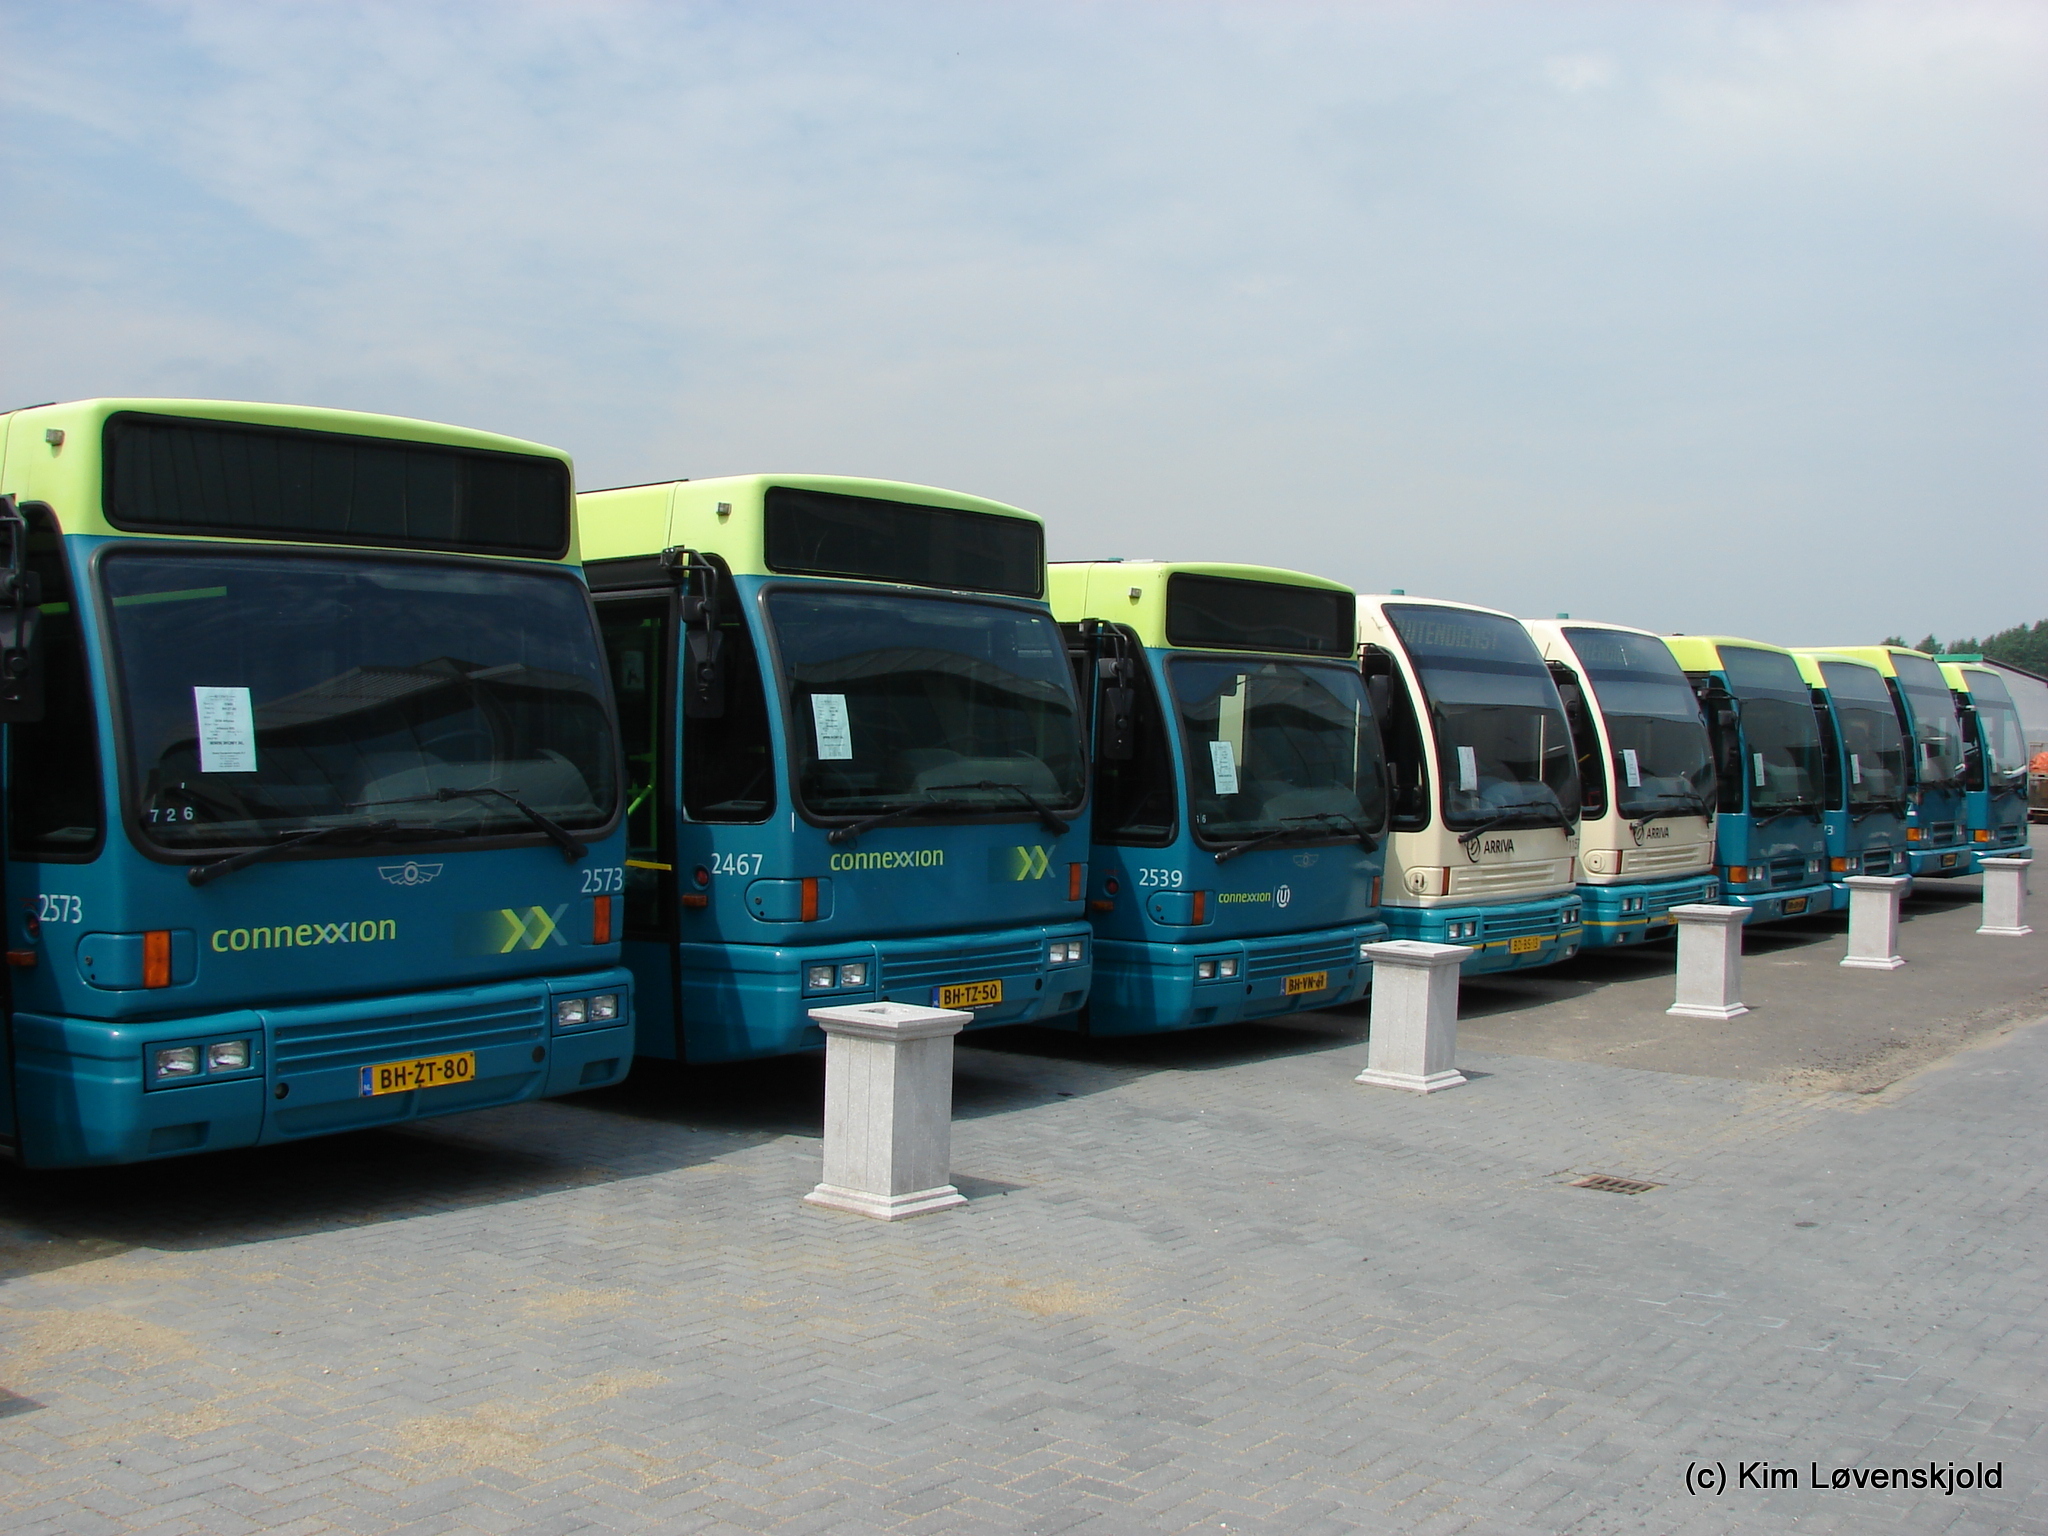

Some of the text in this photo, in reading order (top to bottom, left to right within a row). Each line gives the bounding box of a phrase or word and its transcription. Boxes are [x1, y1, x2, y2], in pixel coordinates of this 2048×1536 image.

[1646, 826, 1670, 839] ARRIVA
[1483, 838, 1515, 855] ARRIVA
[711, 852, 764, 876] 2467
[830, 849, 944, 871] connexxion
[581, 866, 623, 893] 2573
[1139, 868, 1183, 888] 2539
[1218, 890, 1271, 904] connexxion
[38, 893, 83, 924] 2573
[211, 917, 397, 953] connexxion
[943, 983, 998, 1005] BH-TZ-50
[380, 1057, 469, 1089] BH-ZT-80
